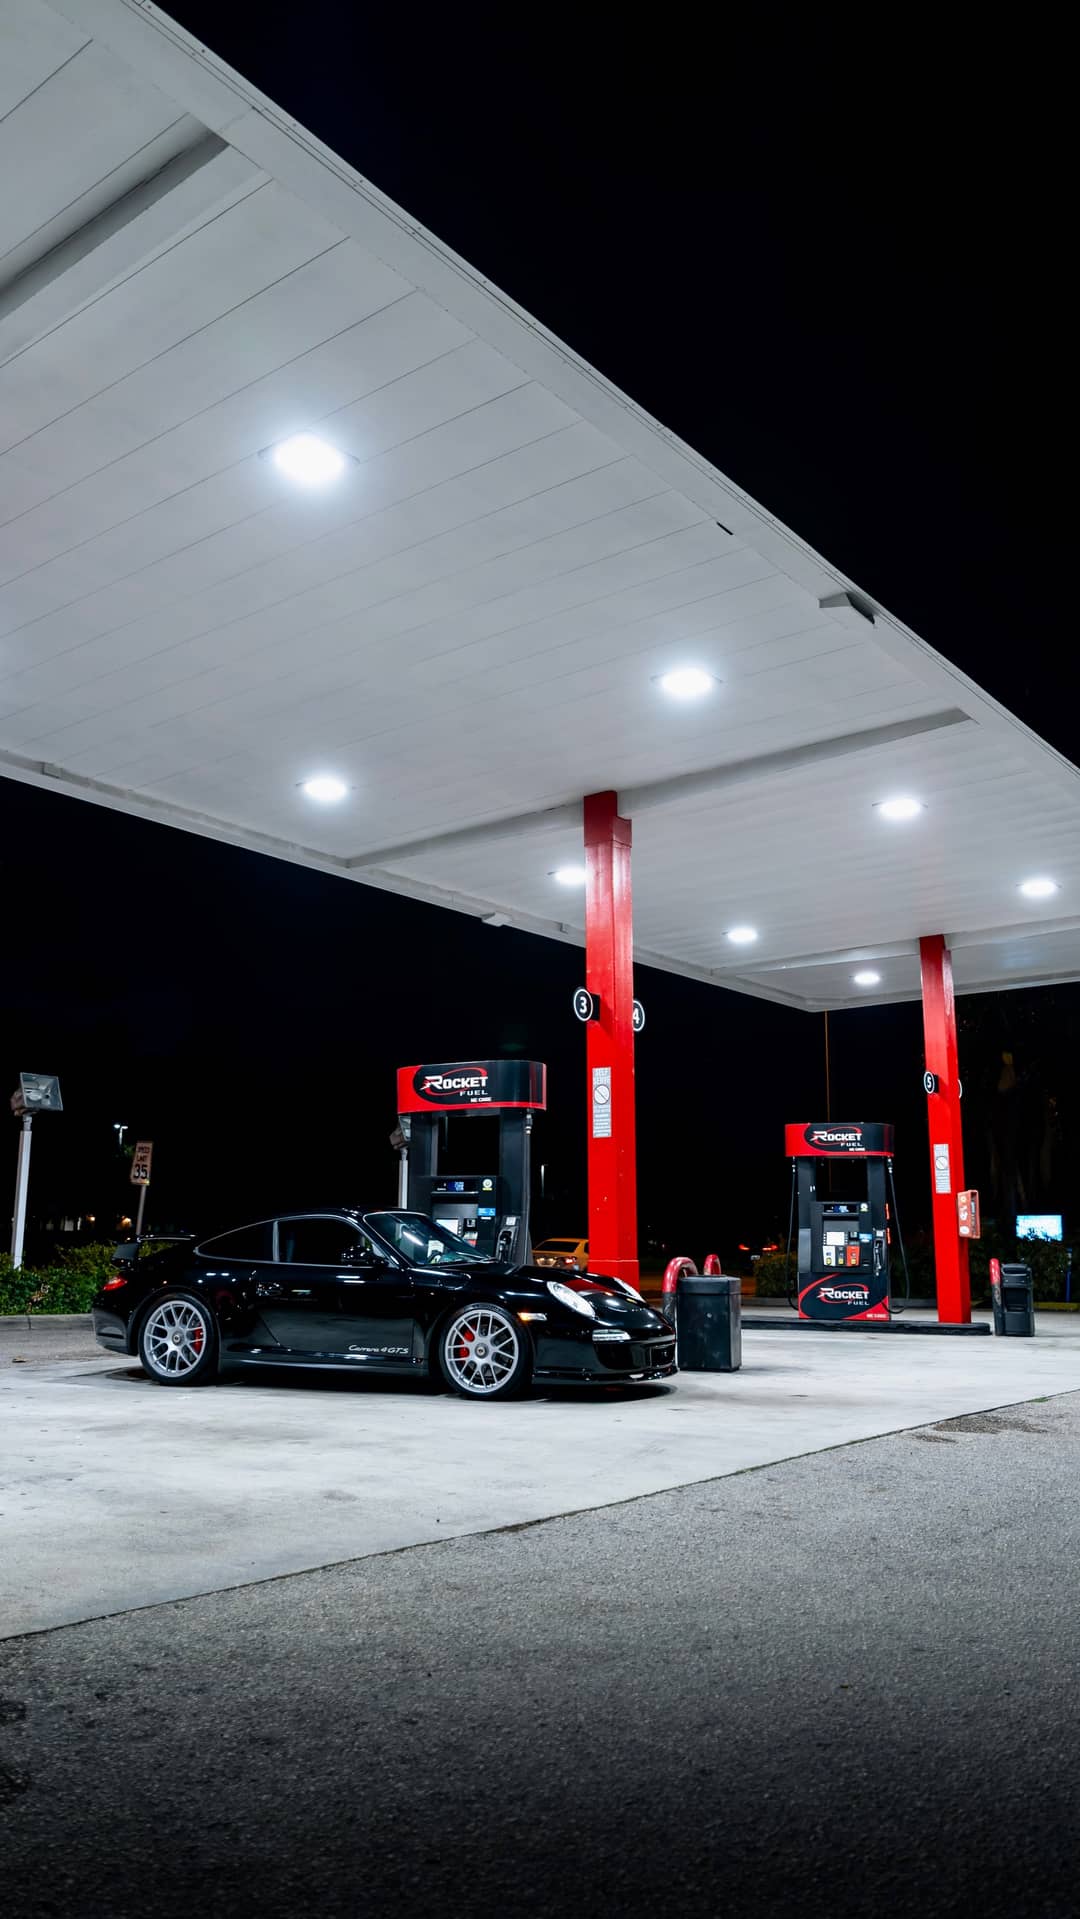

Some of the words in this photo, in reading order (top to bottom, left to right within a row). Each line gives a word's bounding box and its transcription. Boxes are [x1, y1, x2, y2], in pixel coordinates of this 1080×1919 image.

[579, 996, 588, 1014] 3
[632, 1008, 640, 1024] 4
[420, 1075, 489, 1090] ROCKET
[926, 1076, 932, 1089] 5
[459, 1089, 489, 1097] FUEL
[810, 1131, 863, 1142] ROCKET
[133, 1163, 148, 1180] 35
[816, 1287, 870, 1299] ROCKET
[348, 1344, 380, 1353] Carrera
